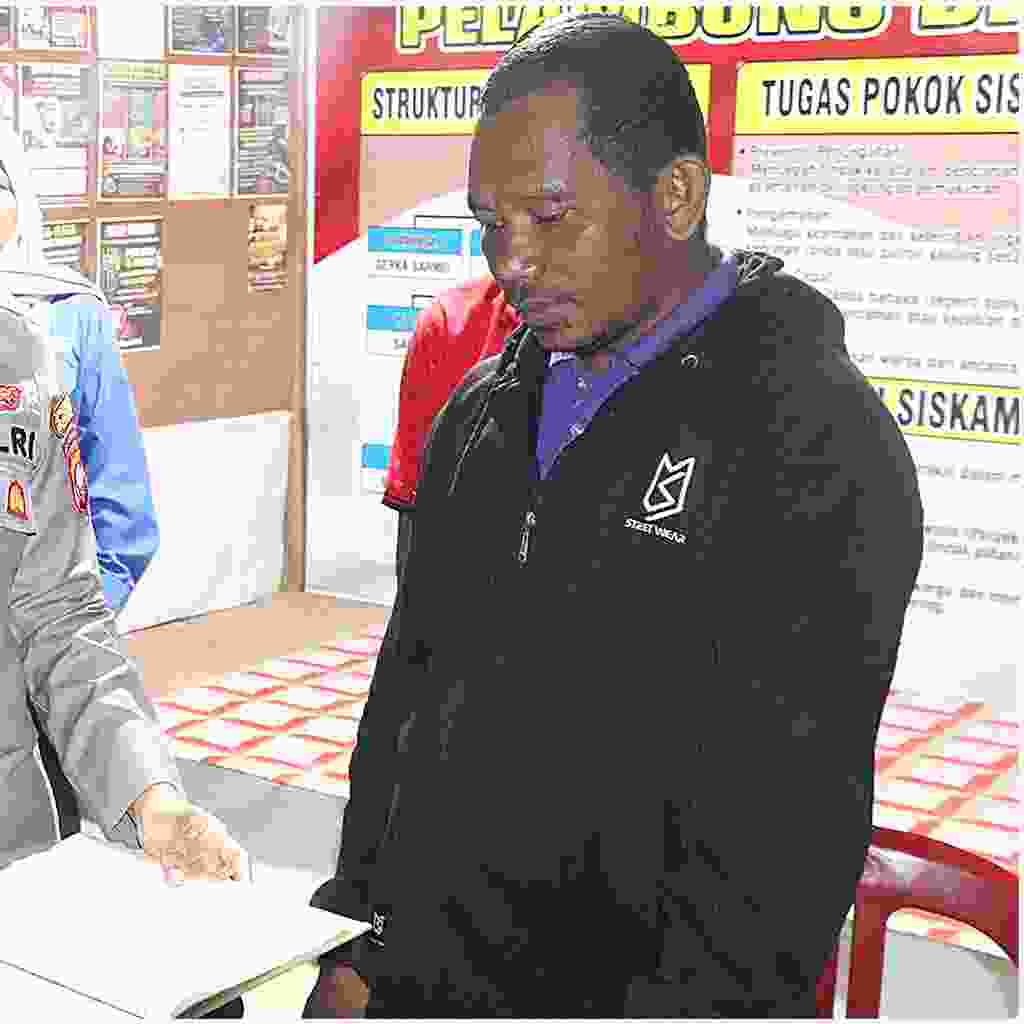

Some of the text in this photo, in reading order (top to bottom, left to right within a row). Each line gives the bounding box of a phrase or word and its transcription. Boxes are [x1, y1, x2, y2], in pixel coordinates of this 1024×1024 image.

[373, 85, 482, 121] STRUKTUR
[762, 77, 851, 117] TUGAS
[863, 74, 965, 116] POKOK
[897, 388, 1020, 435] SISKAM
